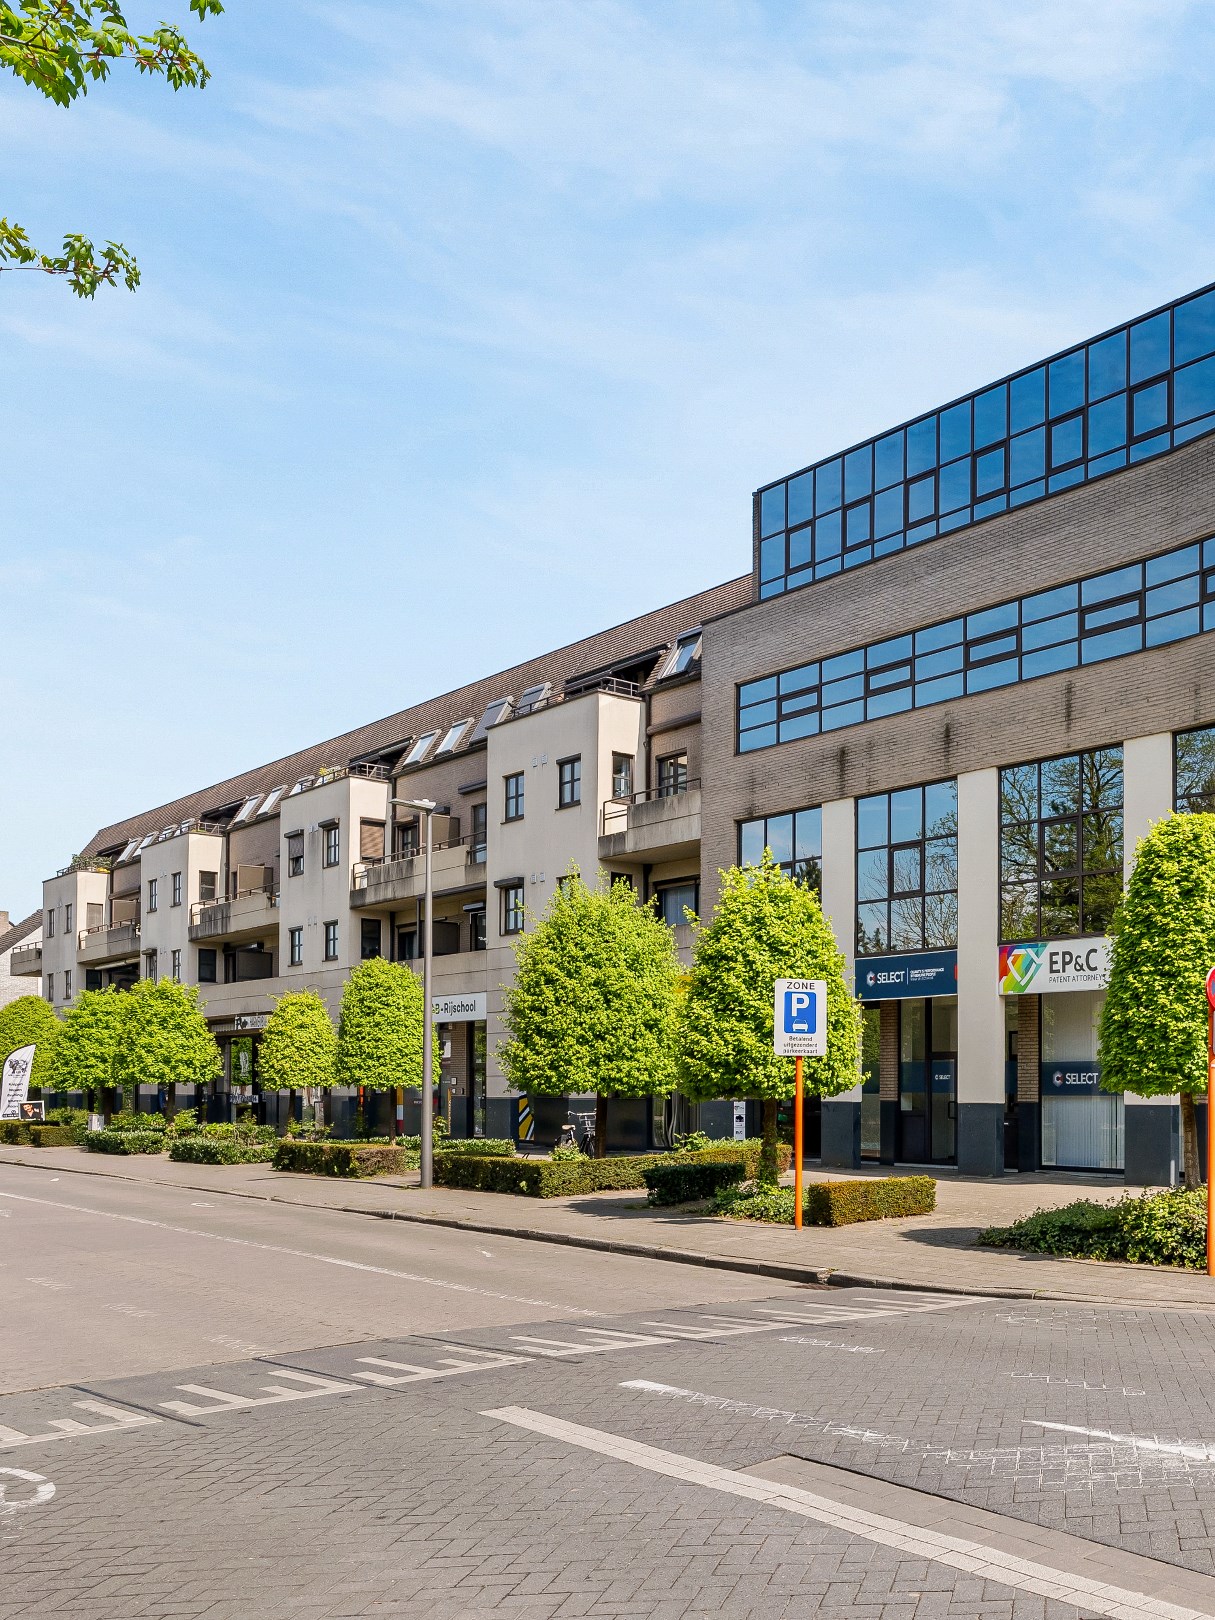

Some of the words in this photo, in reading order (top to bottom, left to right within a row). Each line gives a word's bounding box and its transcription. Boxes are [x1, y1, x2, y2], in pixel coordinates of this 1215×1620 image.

[1049, 948, 1098, 974] EP&C
[877, 971, 905, 984] SELECT
[1049, 975, 1071, 983] PATENT
[786, 982, 815, 990] ZONE
[431, 1000, 476, 1017] B-Rijschool
[791, 993, 810, 1017] P
[1065, 1072, 1099, 1085] SELECT
